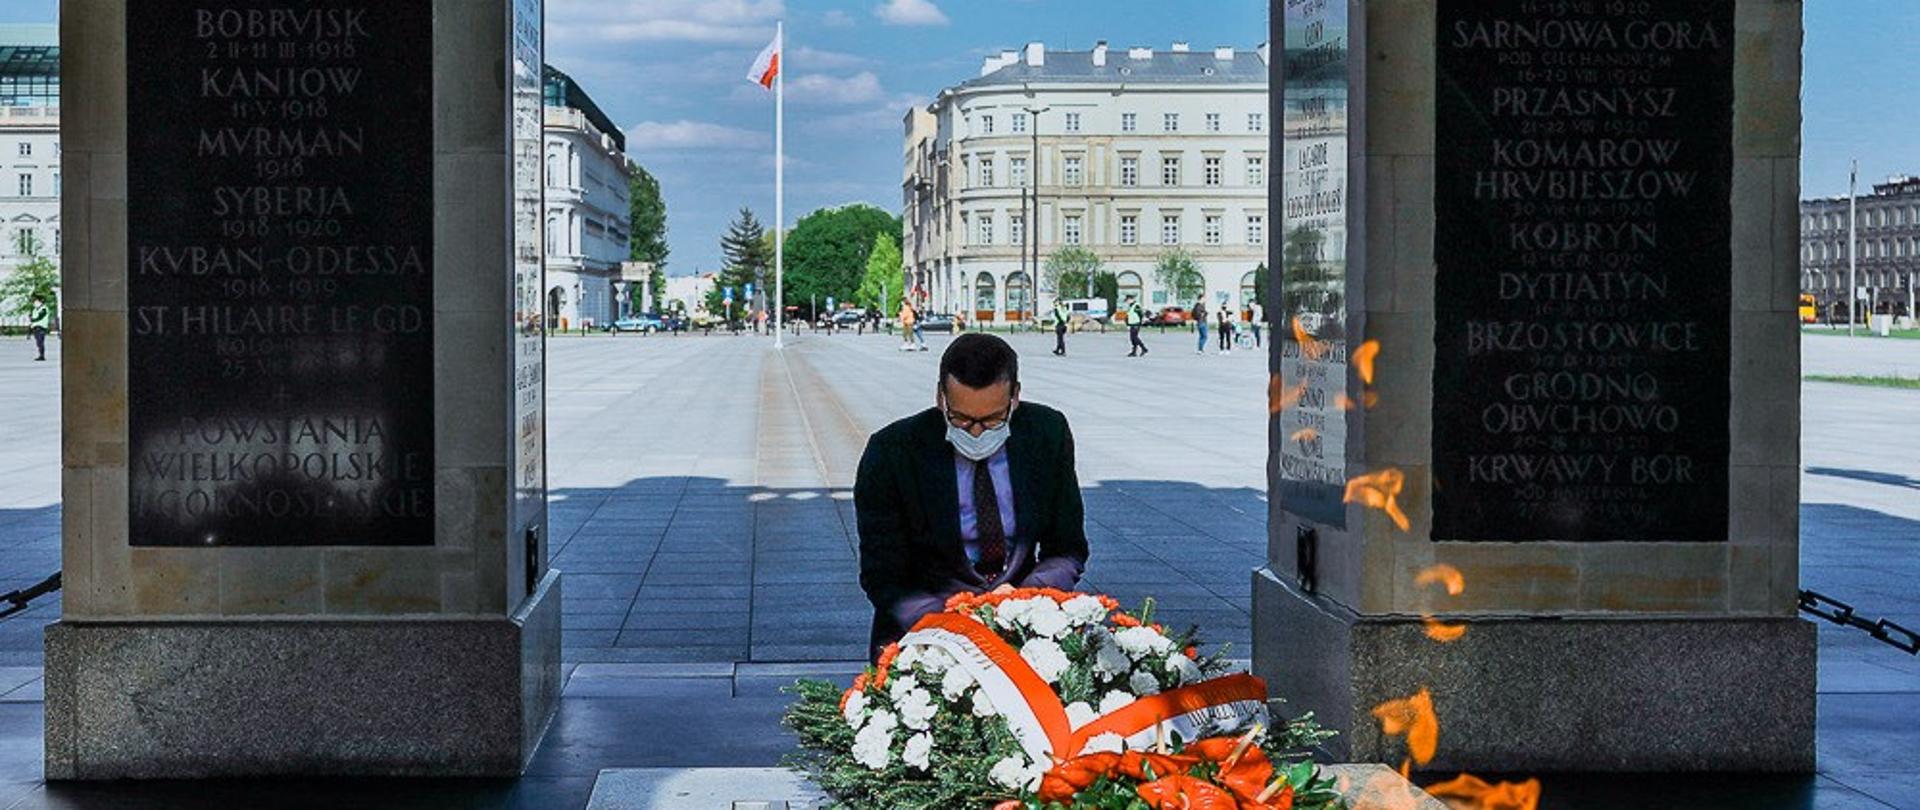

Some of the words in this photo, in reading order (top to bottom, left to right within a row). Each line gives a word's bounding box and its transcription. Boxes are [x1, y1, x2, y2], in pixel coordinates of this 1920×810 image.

[1452, 20, 1618, 49] SARNOWA
[307, 40, 356, 60] 1918
[201, 67, 362, 97] KANIOW
[280, 97, 328, 120] 1918
[1492, 87, 1677, 117] PRZASNYSZ
[197, 127, 364, 156] MVRMAN
[1492, 138, 1682, 167] KOMAROW
[255, 156, 304, 180] 1918
[1474, 170, 1698, 200] HRVBIESZOW
[1509, 221, 1657, 250] KOBRYN
[1499, 271, 1668, 300] DYTIATYN
[181, 305, 318, 336] HILAIRE
[372, 304, 423, 335] GD
[1466, 320, 1700, 352] BRZOSTOWICE
[1504, 371, 1660, 400] GRODNO
[180, 416, 387, 446] POWSTANIA
[1482, 402, 1680, 433] OBVCHOWO
[143, 452, 423, 482] WIELKOPOLSKIE
[1467, 454, 1620, 485] KRWAWY
[1630, 454, 1695, 485] BOR
